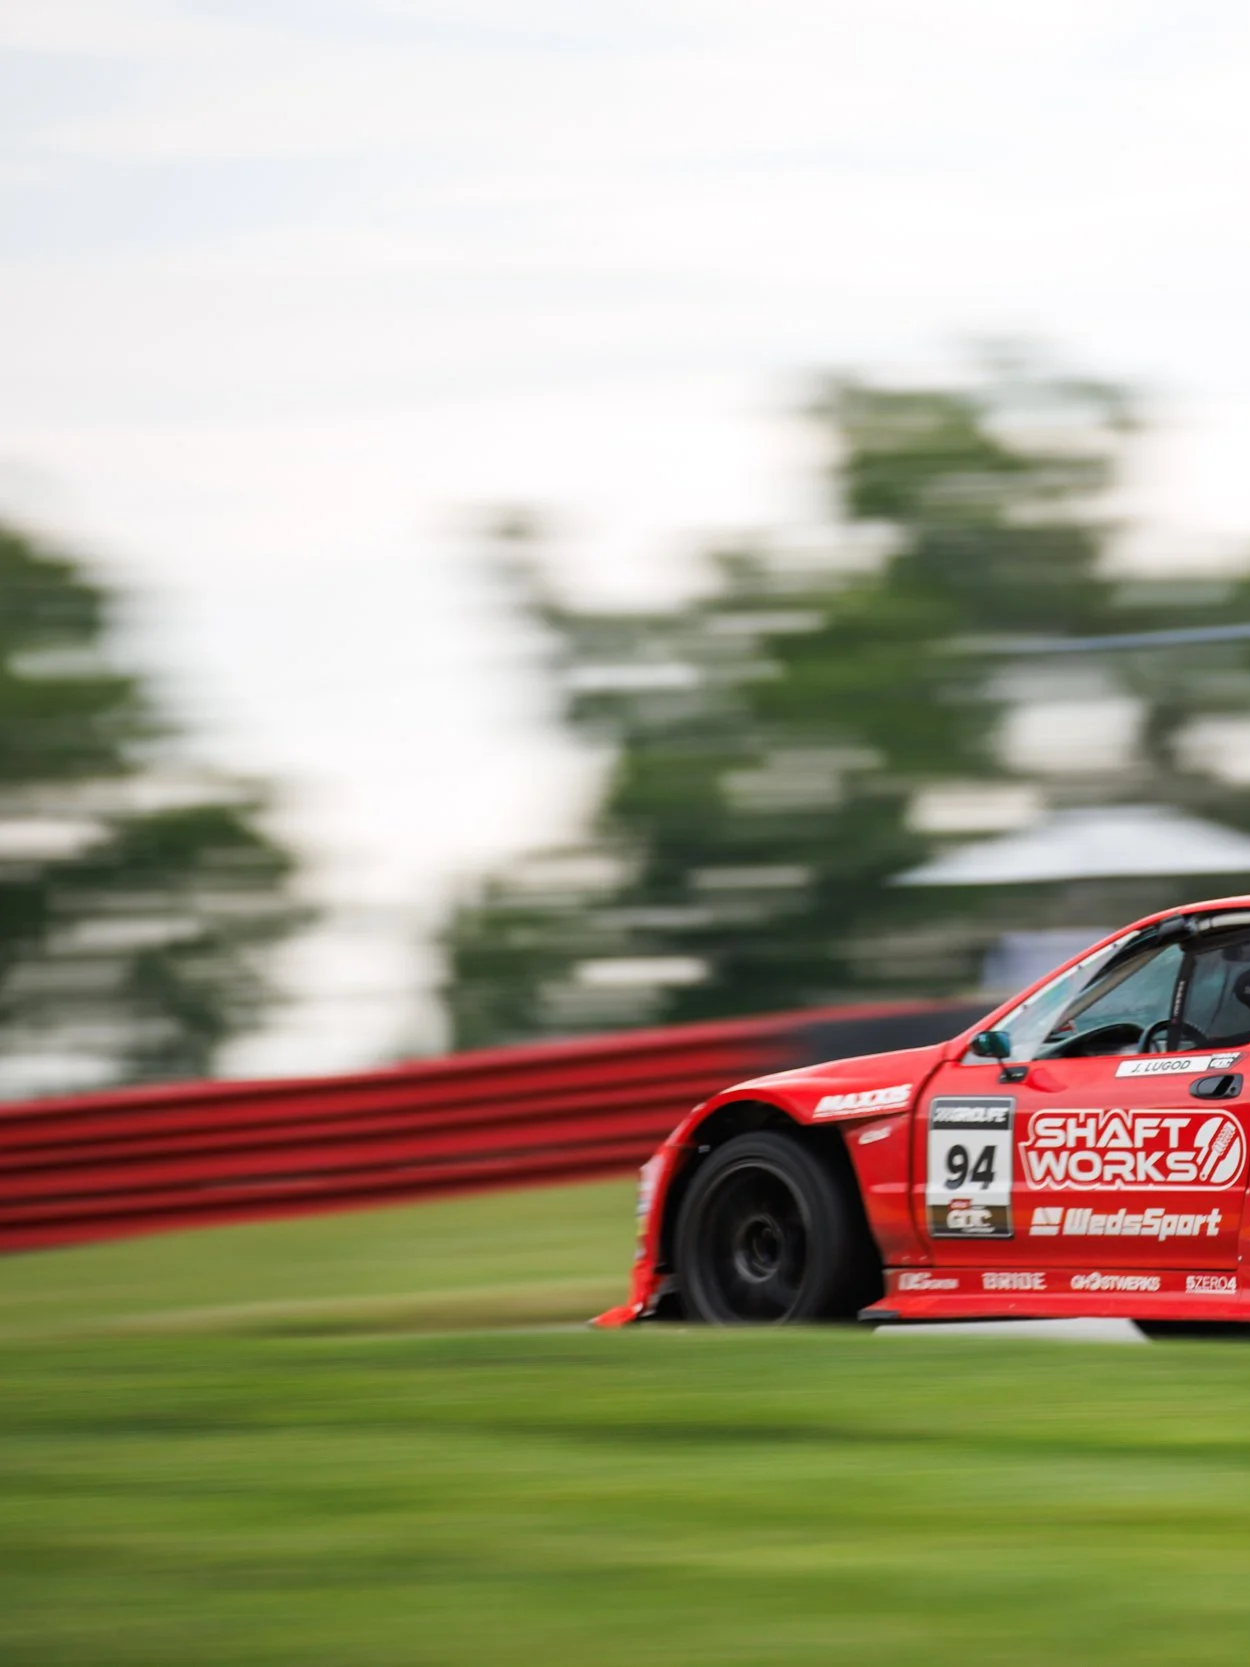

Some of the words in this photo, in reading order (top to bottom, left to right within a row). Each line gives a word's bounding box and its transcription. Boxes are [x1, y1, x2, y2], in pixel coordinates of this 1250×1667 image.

[1131, 1063, 1141, 1073] J.
[1144, 1060, 1191, 1072] LUGOD
[814, 1084, 912, 1113] MAXXIS
[1035, 1117, 1191, 1149] SHAFT
[944, 1144, 997, 1190] 94
[1027, 1150, 1198, 1182] WORKS
[1063, 1208, 1221, 1241] WedsSport
[982, 1272, 1047, 1290] BRIDE
